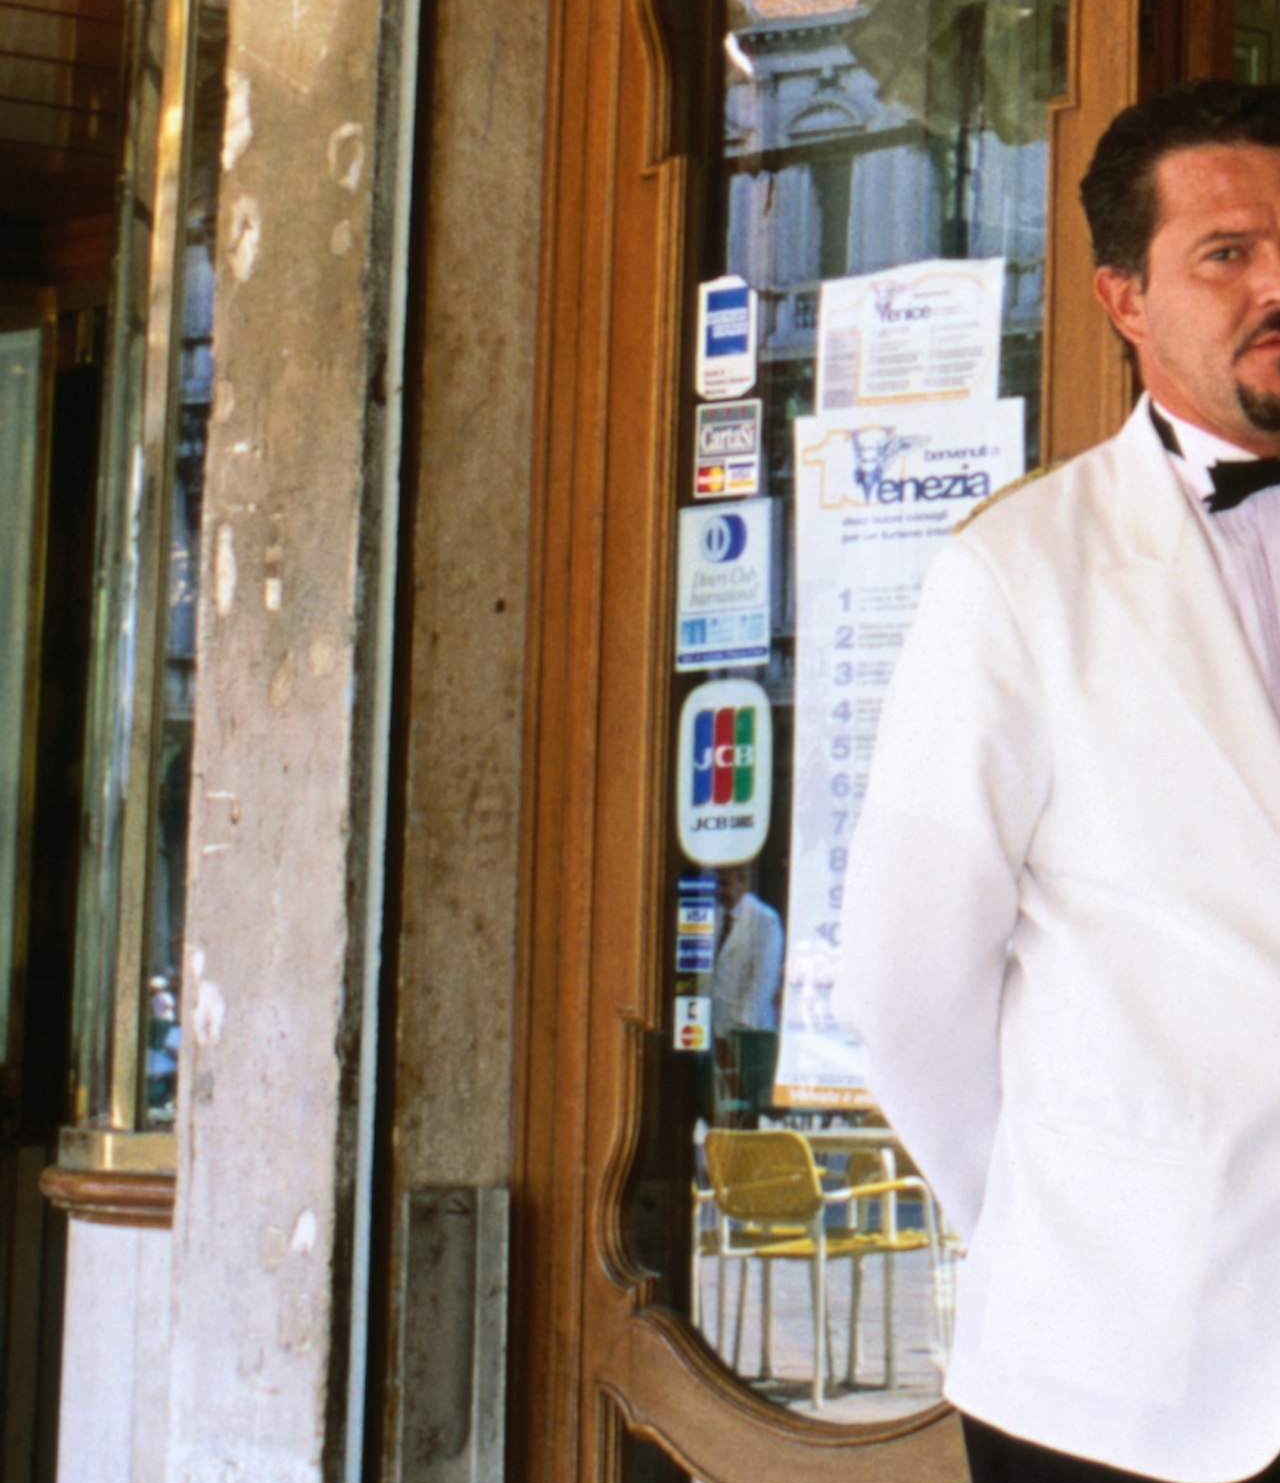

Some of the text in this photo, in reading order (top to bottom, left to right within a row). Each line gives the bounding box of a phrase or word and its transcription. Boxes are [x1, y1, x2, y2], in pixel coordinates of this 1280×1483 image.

[924, 444, 987, 463] benvenuti
[853, 460, 990, 505] Venezia
[837, 586, 853, 613] 1
[834, 624, 855, 650] 2
[832, 660, 854, 687] 3
[831, 698, 853, 723] 4
[692, 743, 755, 770] JCB
[831, 735, 851, 761] 5
[831, 772, 850, 799] 6
[690, 815, 728, 832] JCB
[832, 810, 849, 836] 7
[829, 846, 848, 872] 8
